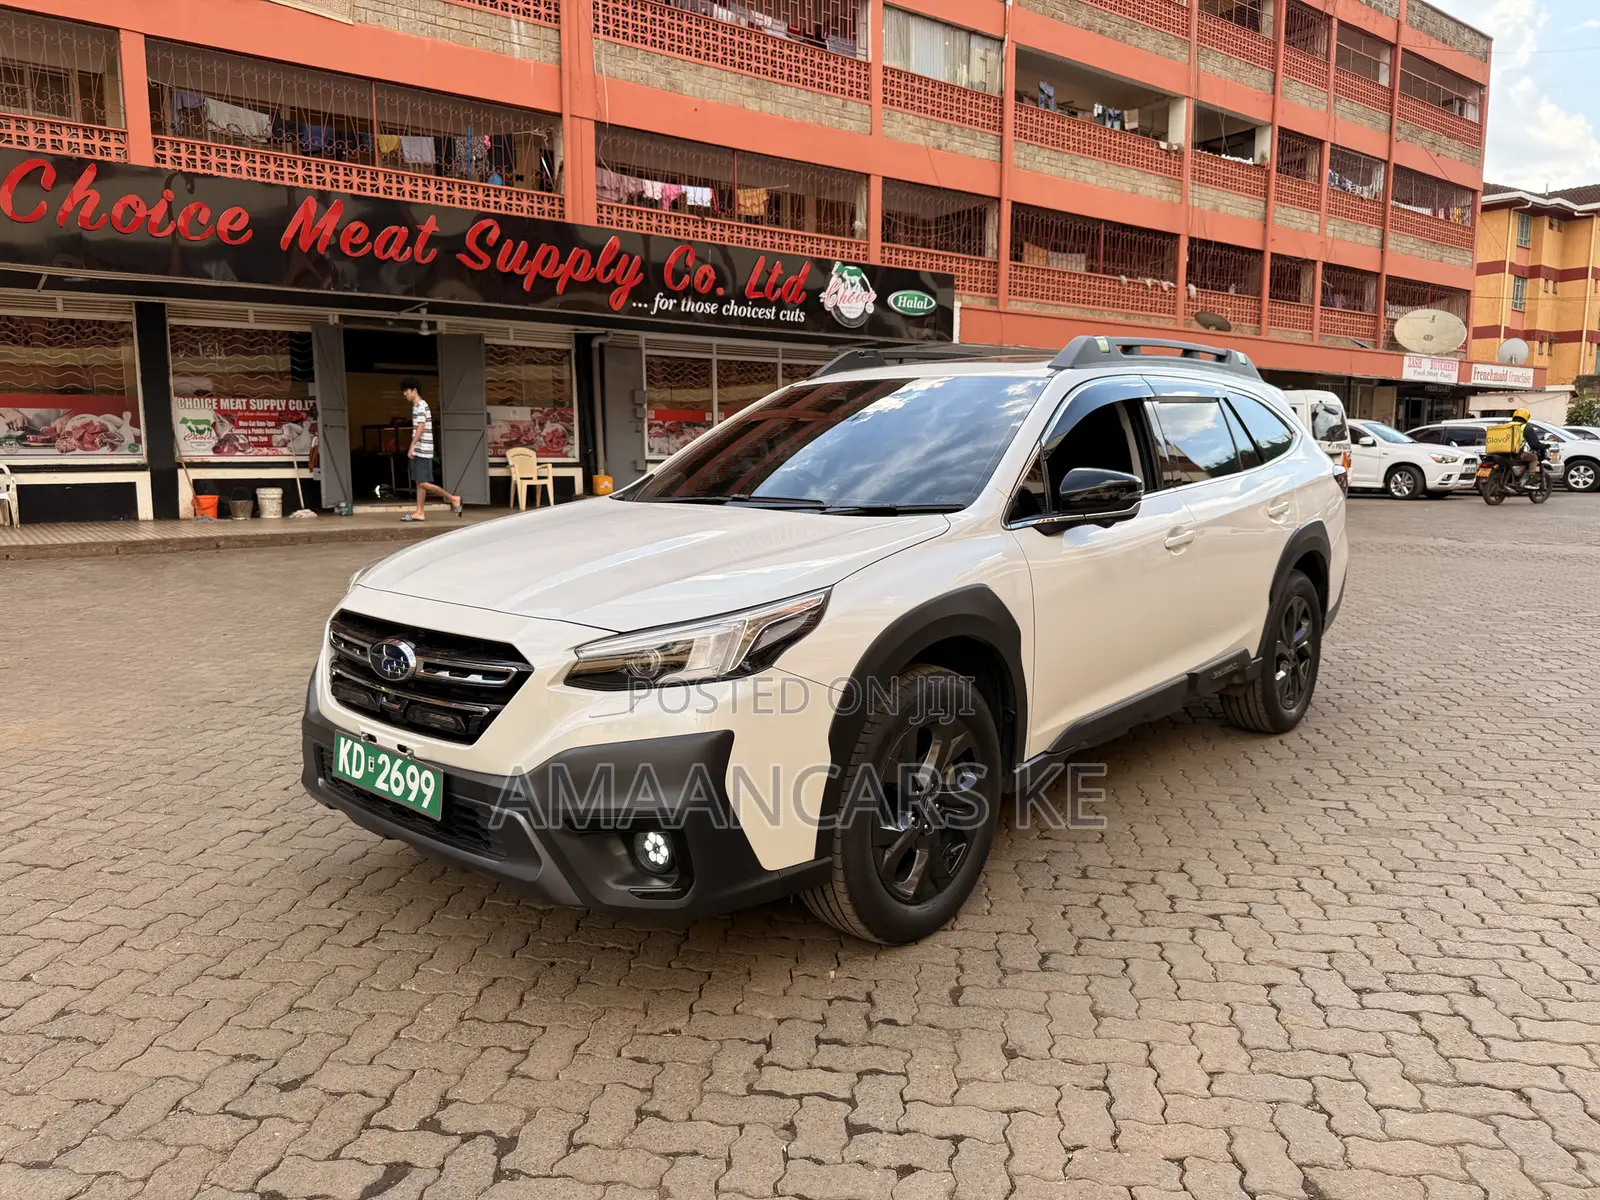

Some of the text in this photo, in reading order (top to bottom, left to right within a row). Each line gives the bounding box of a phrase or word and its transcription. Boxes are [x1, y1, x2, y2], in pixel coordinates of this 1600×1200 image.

[0, 159, 811, 311] Choice Meat Supply Co. Ltd
[827, 280, 873, 306] Choice
[898, 295, 928, 309] Halal
[650, 292, 677, 315] for
[680, 298, 718, 315] those
[722, 300, 776, 319] choicest
[779, 309, 806, 323] cuts
[177, 398, 218, 410] CHOICE
[220, 398, 248, 410] MEAT
[249, 399, 288, 411] SUPPLY
[338, 737, 435, 809] KD 2699
